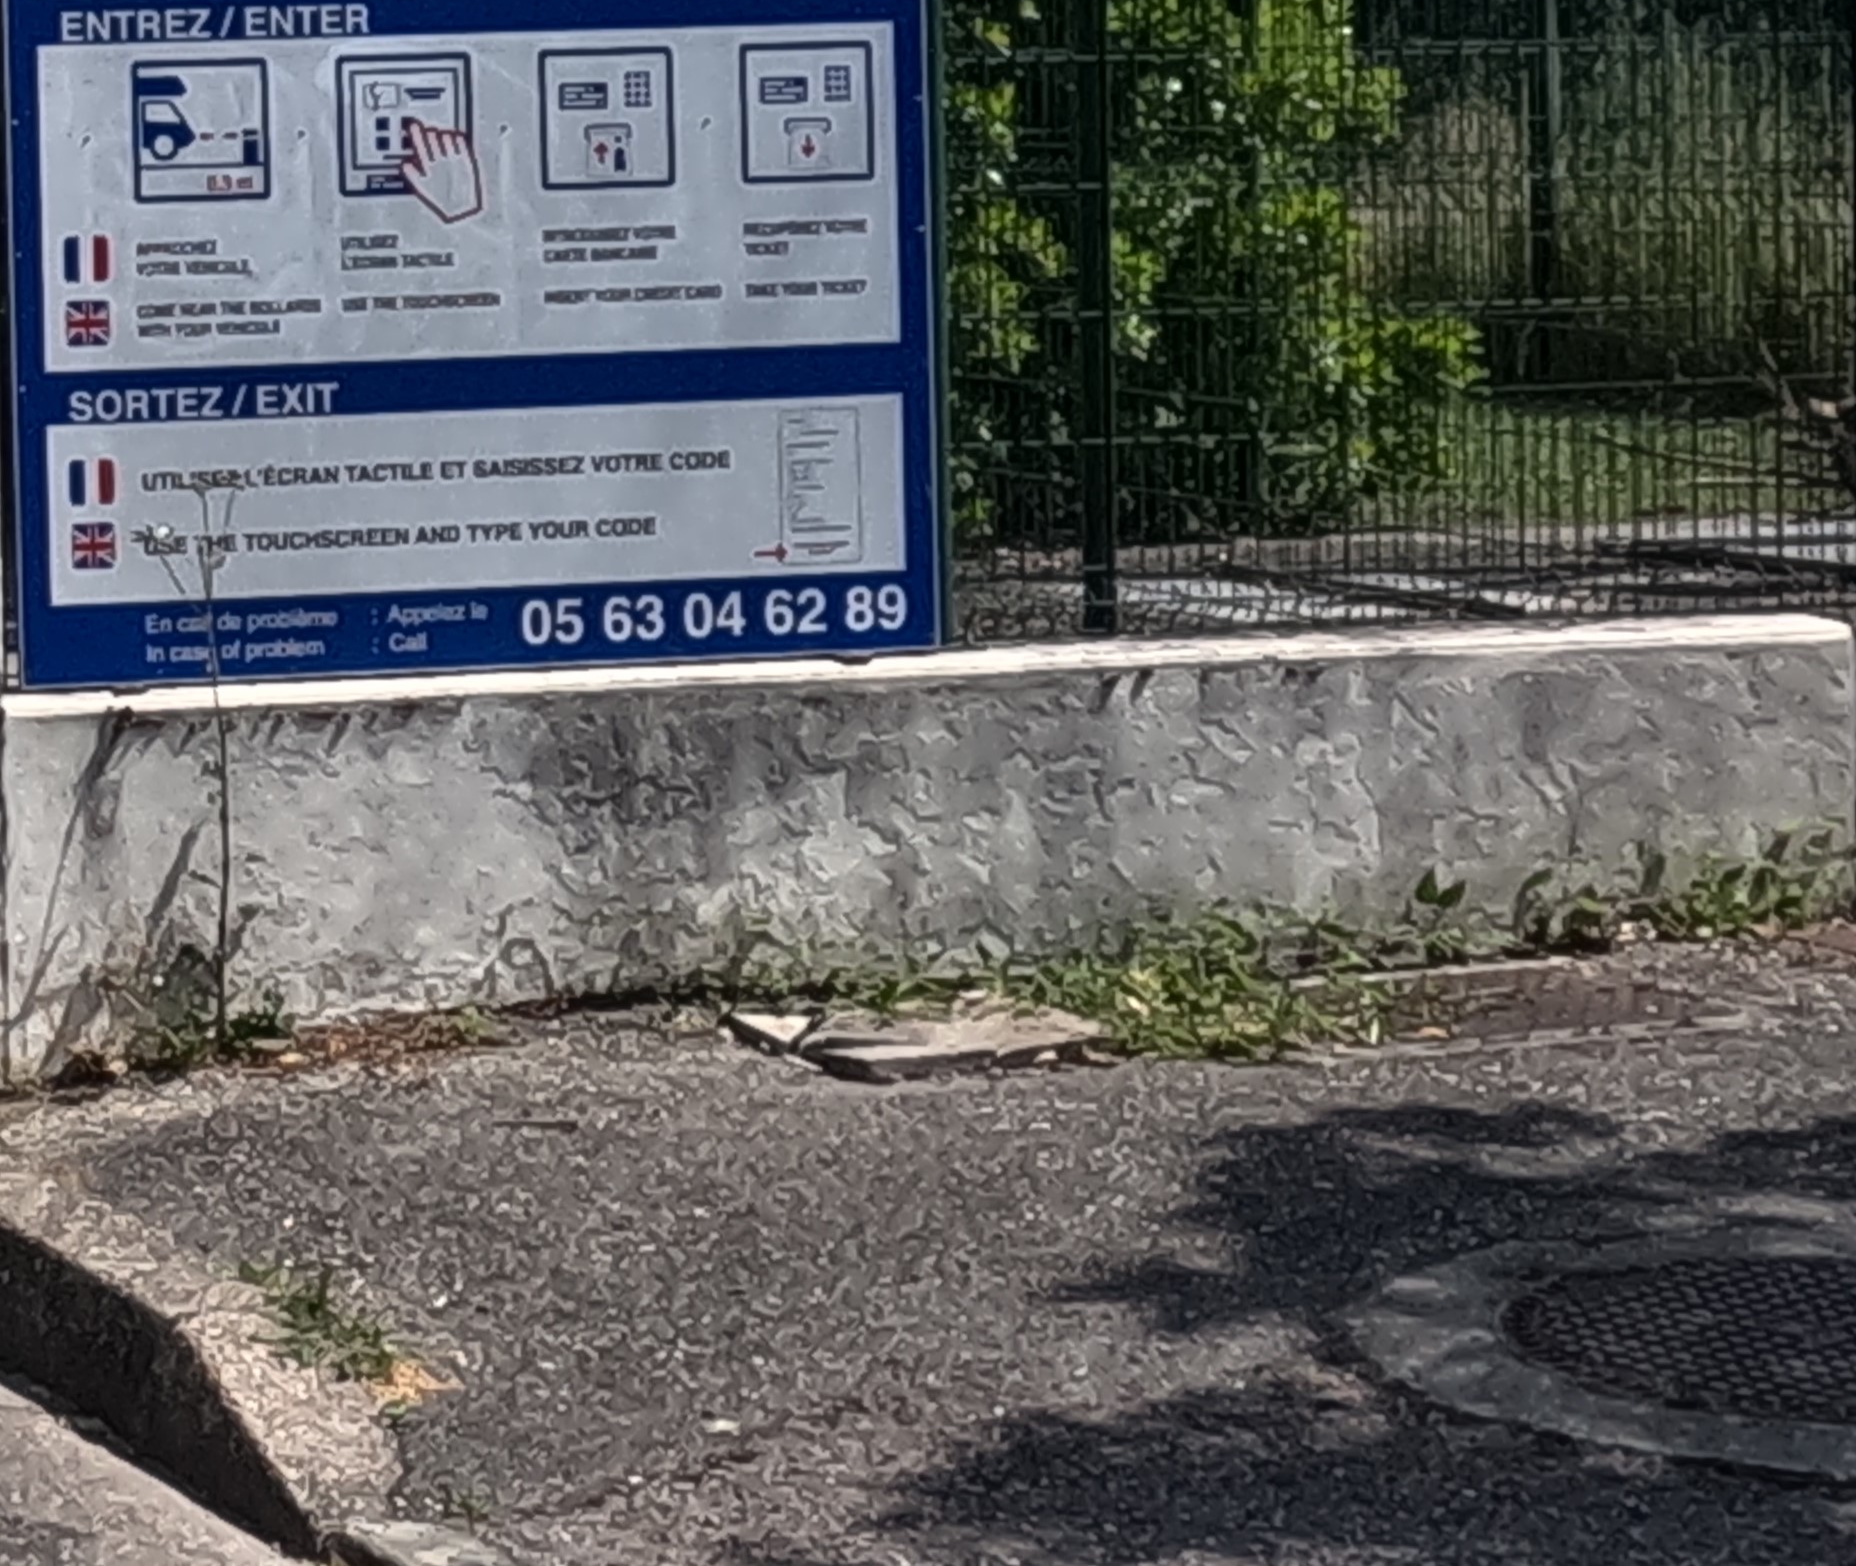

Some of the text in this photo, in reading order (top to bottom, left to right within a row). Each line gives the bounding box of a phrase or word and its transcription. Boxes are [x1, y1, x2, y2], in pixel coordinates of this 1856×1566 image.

[61, 4, 372, 45] ENTREZ / ENTER
[67, 383, 341, 425] SORTEZ / EXIT
[345, 462, 433, 482] TACTILE
[441, 461, 466, 479] ET
[591, 454, 662, 472] VOTRE
[670, 451, 731, 470] CODE
[414, 525, 460, 544] AND
[468, 522, 522, 544] TYPE
[530, 518, 591, 541] YOUR
[598, 515, 656, 538] CODE
[145, 614, 172, 634] En
[523, 585, 906, 644] 05 63 04 62 89
